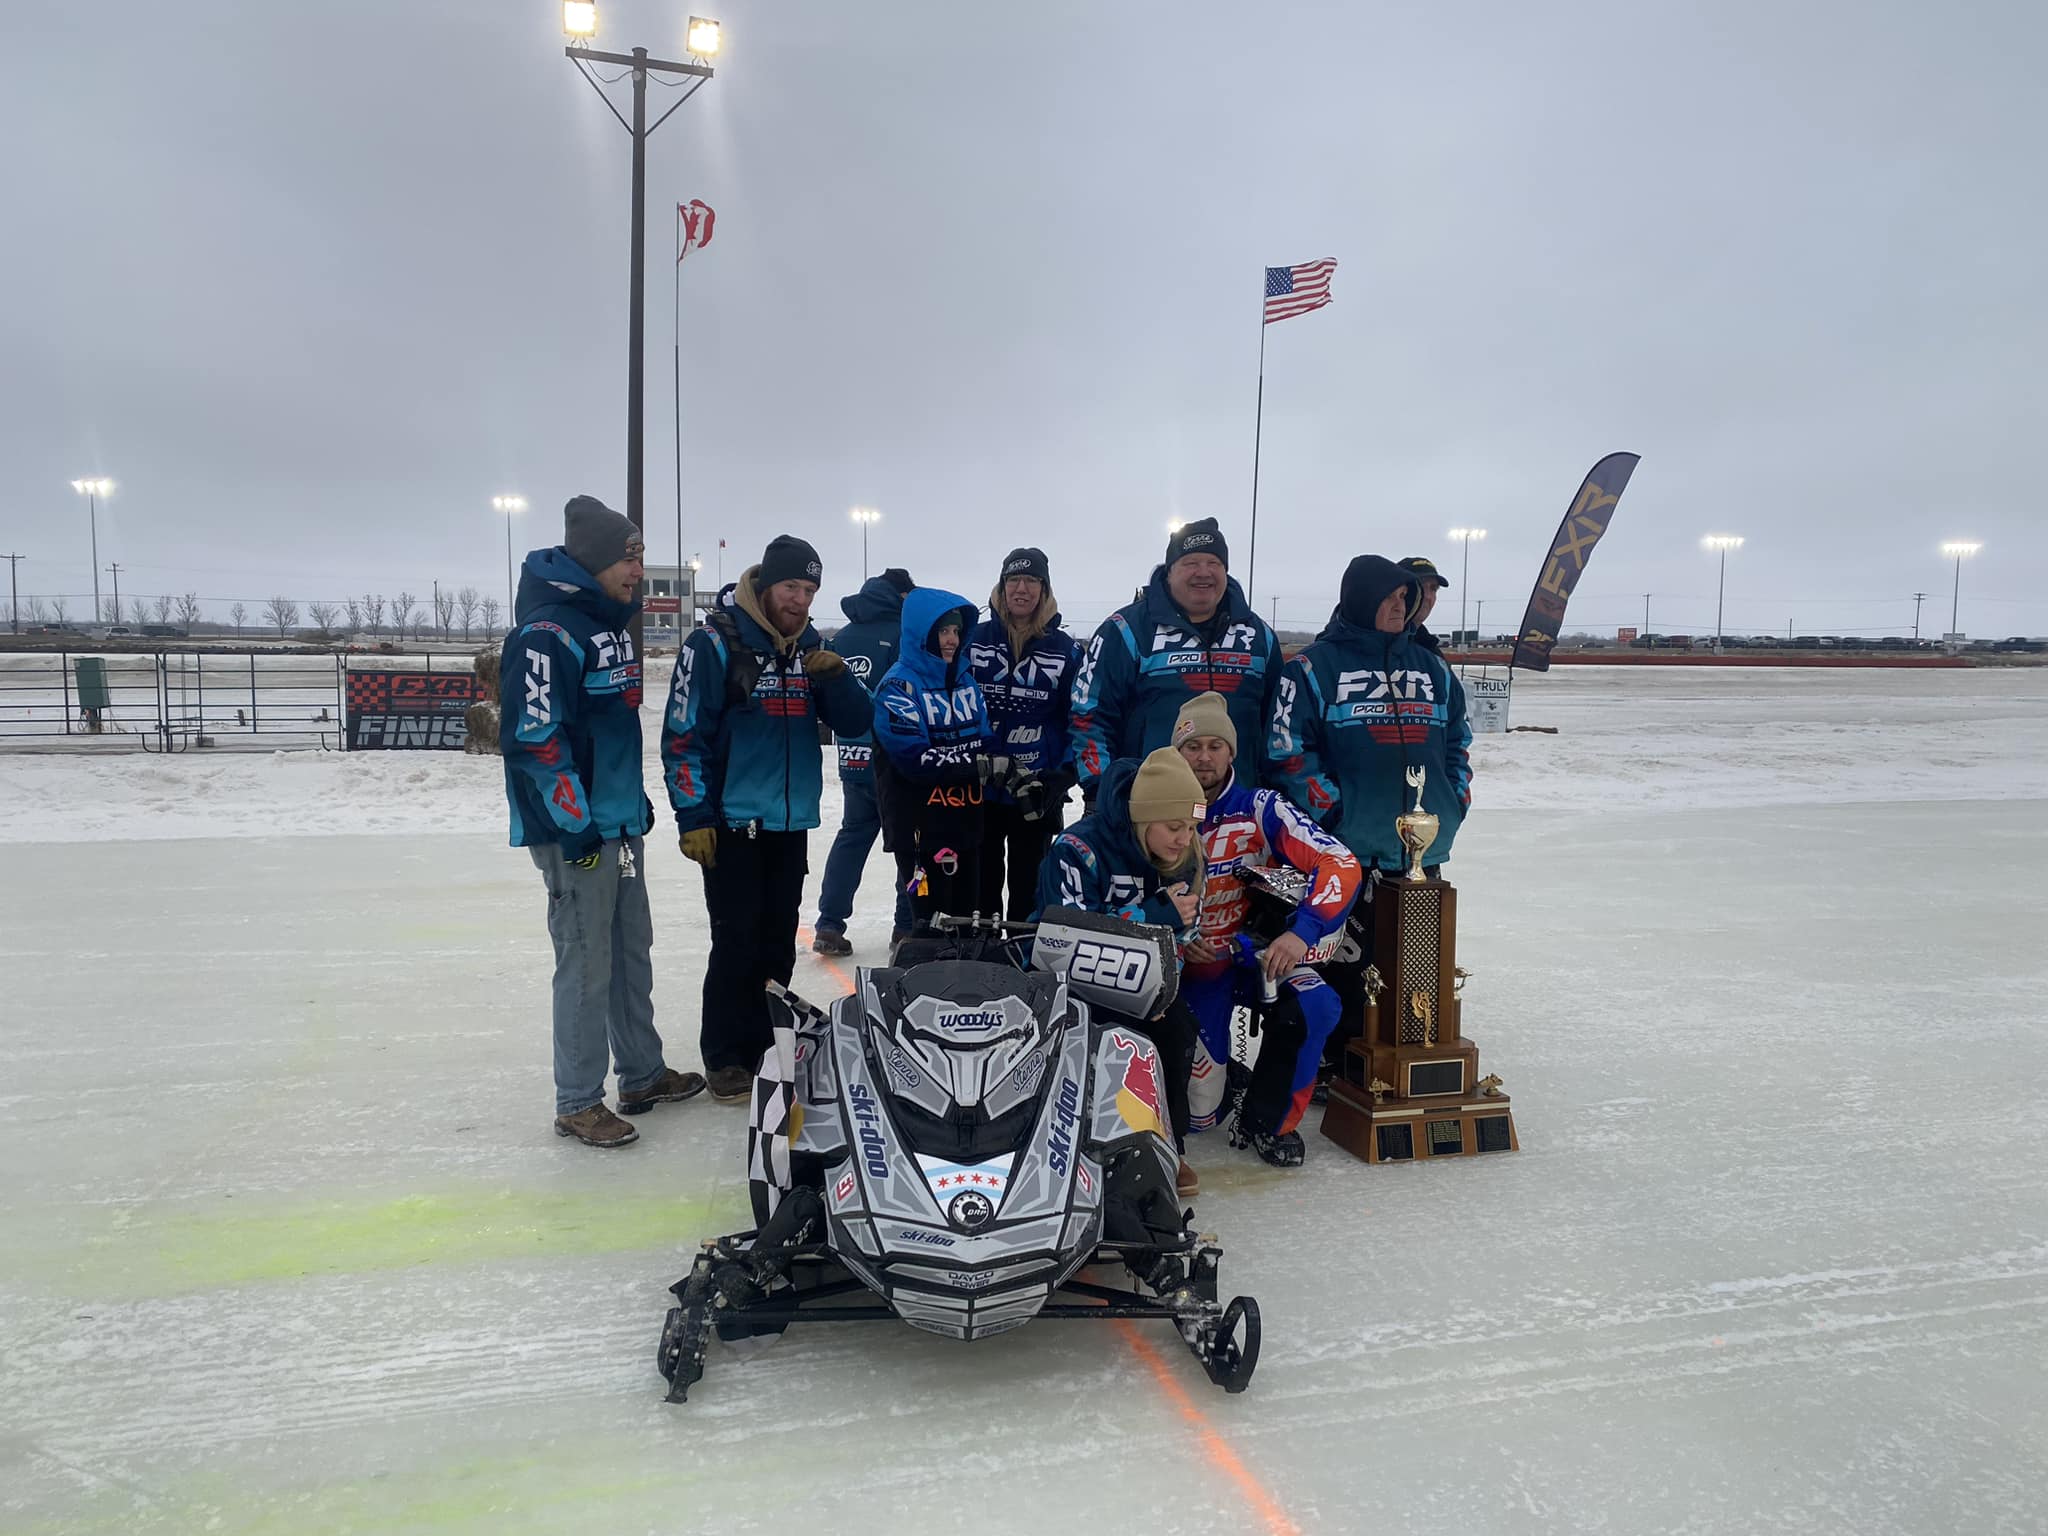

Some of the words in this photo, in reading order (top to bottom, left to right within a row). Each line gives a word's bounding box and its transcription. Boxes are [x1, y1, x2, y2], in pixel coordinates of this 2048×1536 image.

[1541, 482, 1618, 600] FXR
[970, 648, 1066, 690] FXR
[1169, 654, 1200, 664] PRO
[1336, 670, 1434, 703] FXR
[1474, 682, 1508, 691] TRULY
[922, 686, 978, 726] FXR
[1353, 704, 1385, 714] PRO
[1386, 703, 1433, 715] RACE
[356, 716, 468, 745] FINIS
[1208, 858, 1243, 878] ACE
[1306, 943, 1337, 961] Bull
[1071, 942, 1149, 992] 220
[848, 1083, 889, 1178] ski-doo
[1048, 1077, 1079, 1178] ski-doo
[900, 1230, 956, 1247] ski-doo
[948, 1271, 994, 1282] DAYCO
[952, 1279, 990, 1289] POWER
